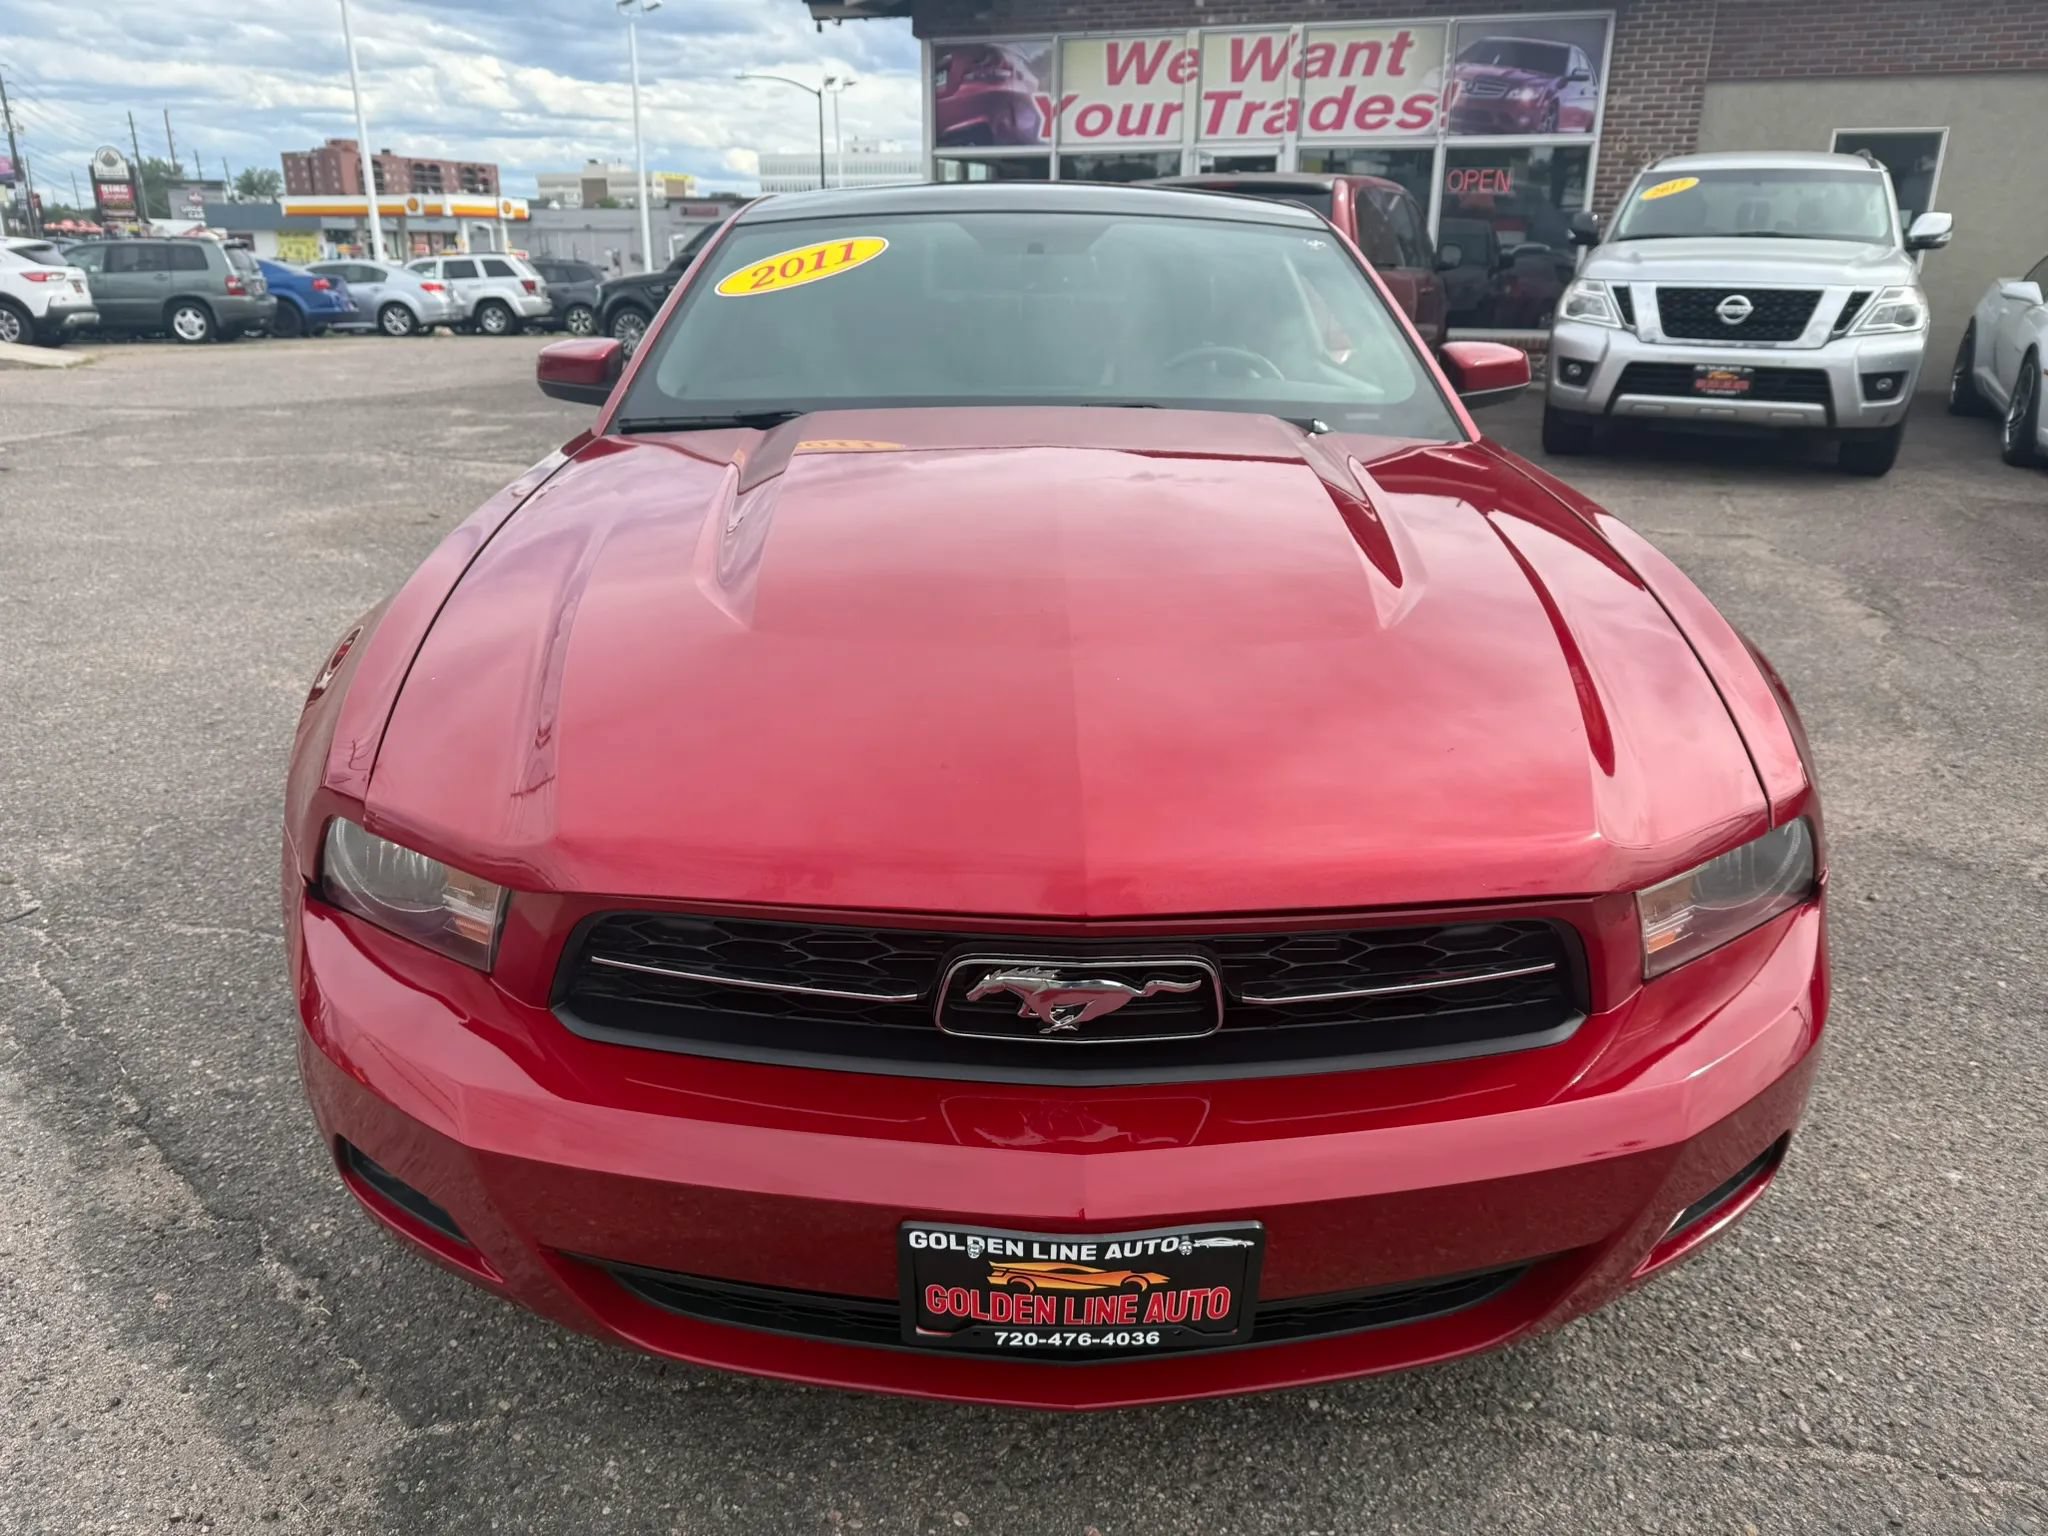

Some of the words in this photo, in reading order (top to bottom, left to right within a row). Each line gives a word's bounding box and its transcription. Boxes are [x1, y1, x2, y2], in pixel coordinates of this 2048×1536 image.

[1106, 40, 1200, 86] We
[1229, 31, 1415, 83] Want
[1033, 93, 1185, 138] Your
[1202, 80, 1460, 136] Trades!
[1447, 168, 1514, 193] OPEN
[750, 241, 857, 290] 2011
[908, 1230, 1024, 1258] GOLDEN
[1032, 1241, 1097, 1261] LINE
[1104, 1236, 1180, 1260] AUTO
[924, 1283, 1057, 1325] GOLDEN
[1063, 1294, 1138, 1326] LINE
[1143, 1285, 1232, 1324] AUTO
[994, 1331, 1161, 1347] 720-476-4036
